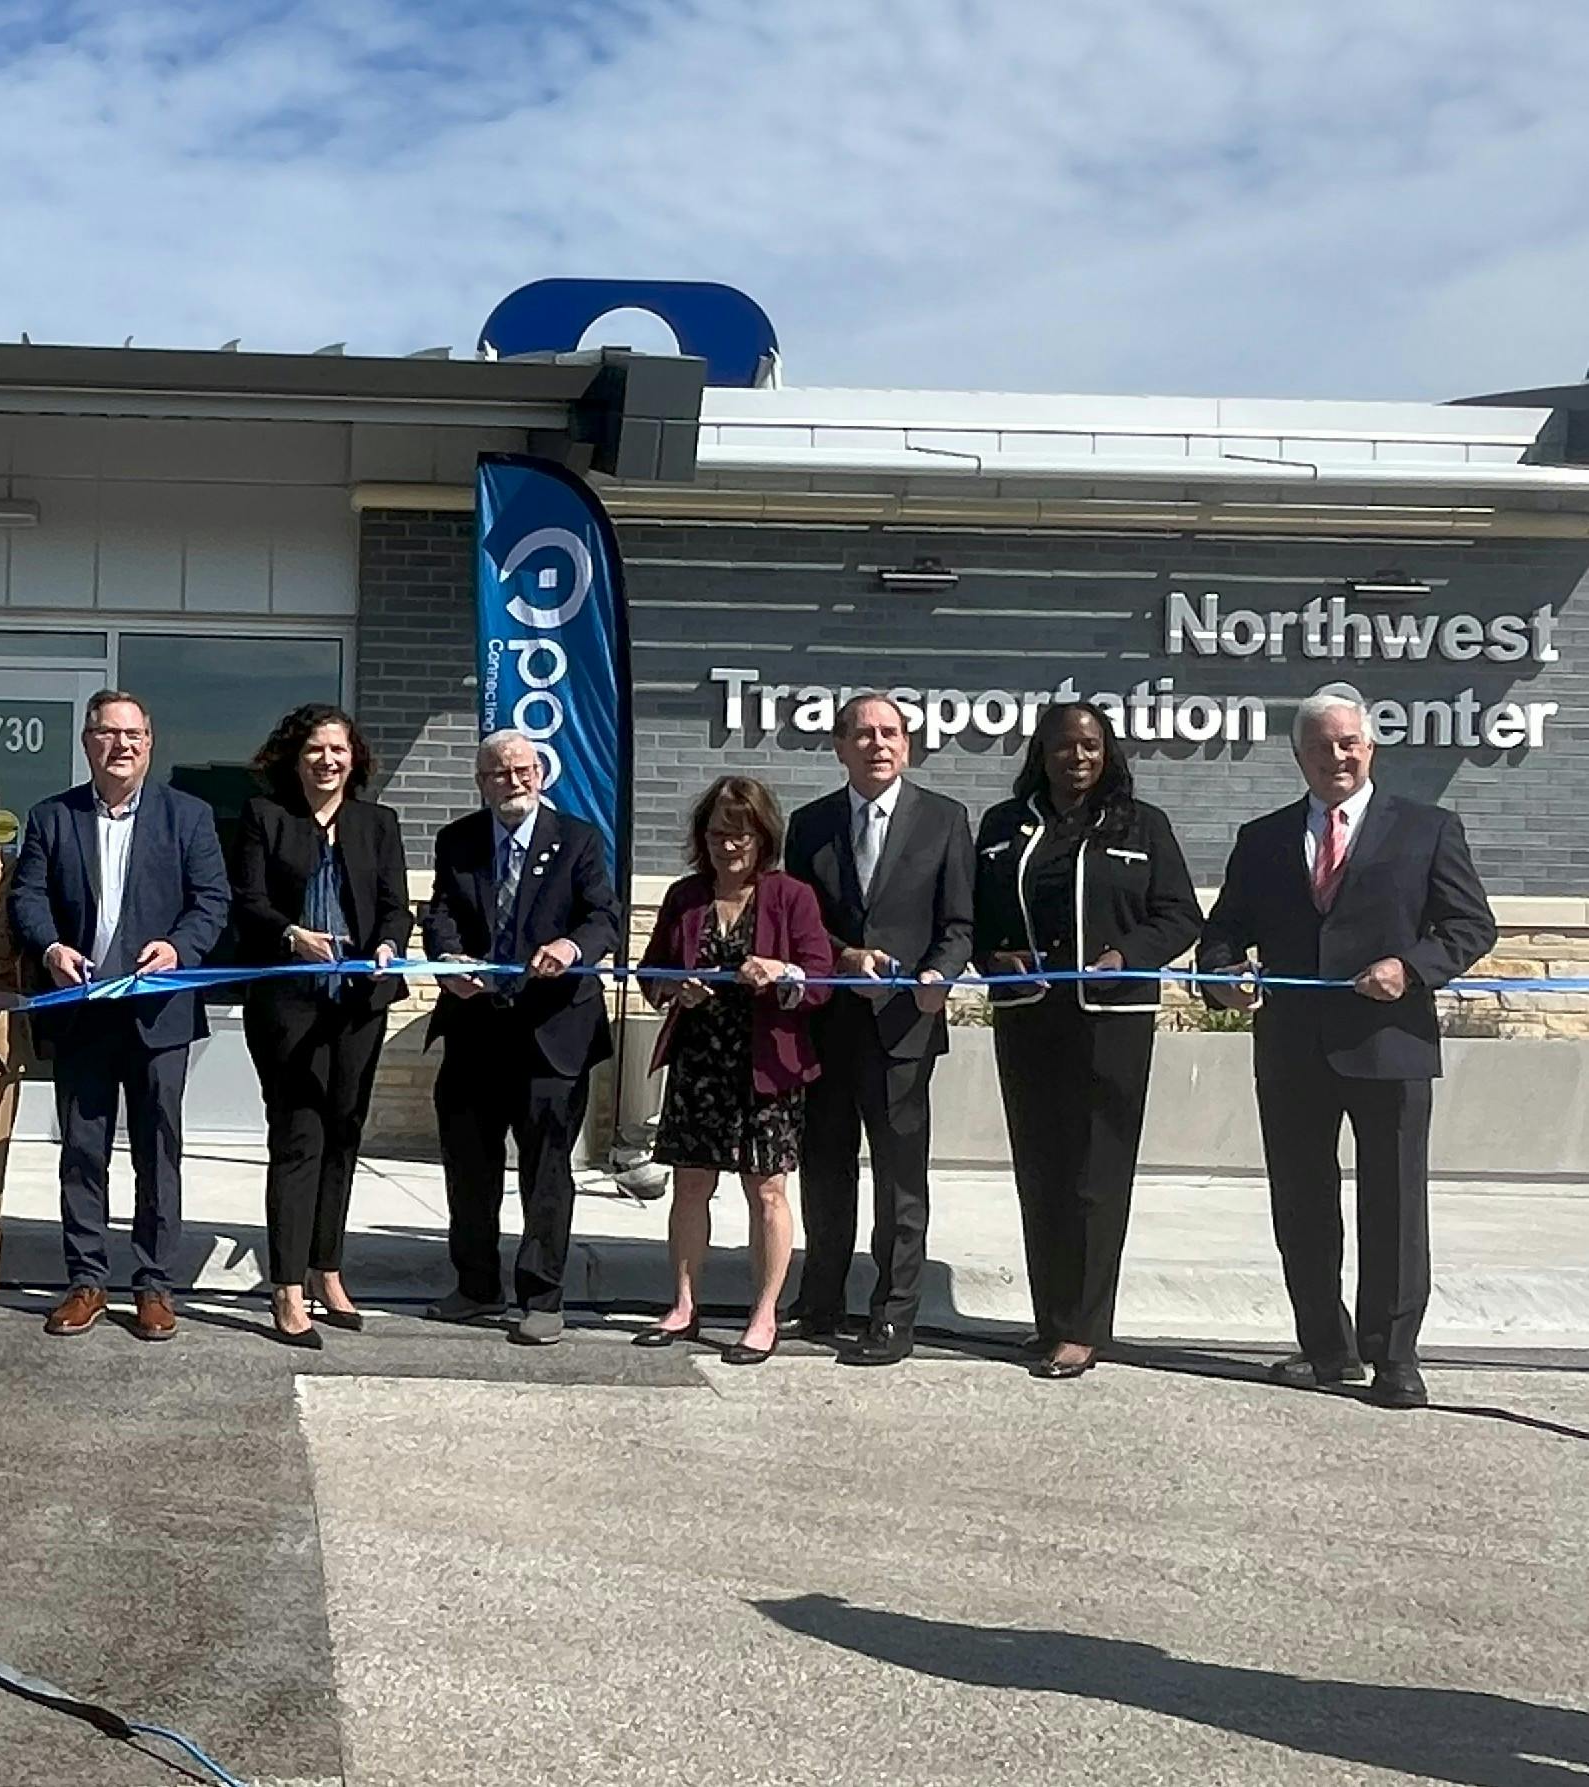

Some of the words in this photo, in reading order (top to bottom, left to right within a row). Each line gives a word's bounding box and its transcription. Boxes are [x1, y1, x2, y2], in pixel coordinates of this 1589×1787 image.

[1165, 592, 1560, 662] Northwest
[508, 638, 567, 811] pac
[711, 668, 1267, 749] Trasporation
